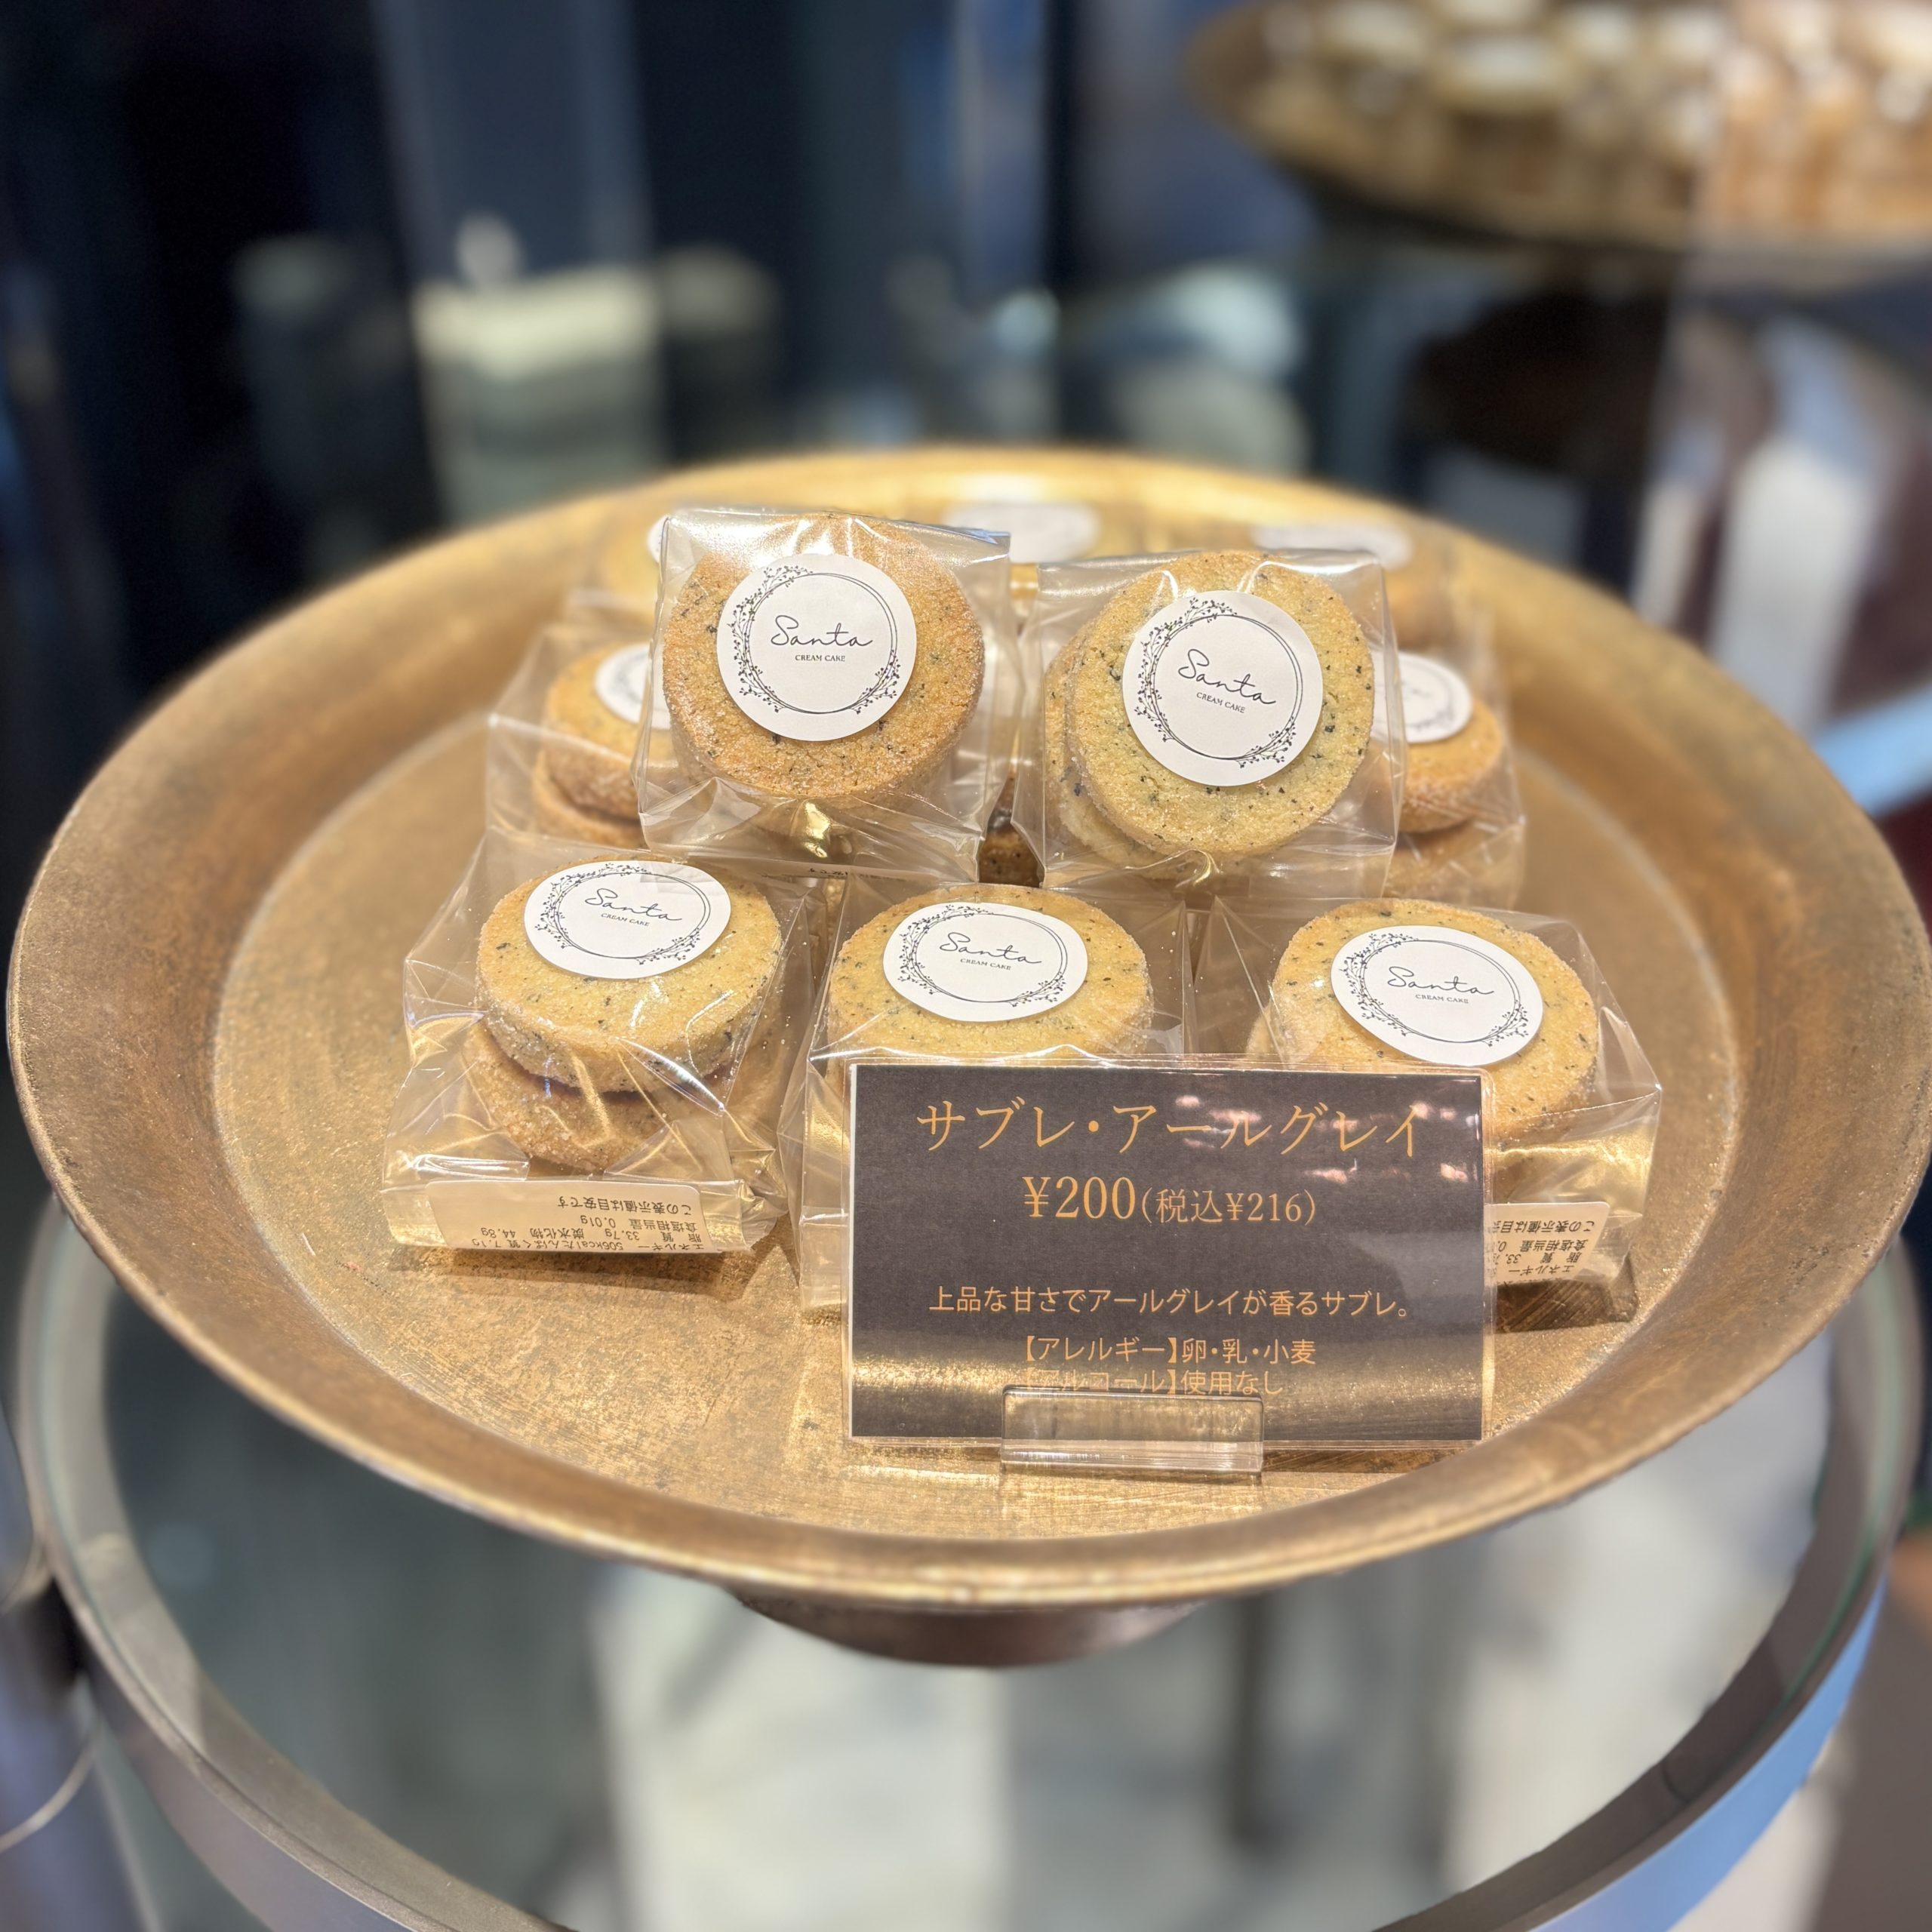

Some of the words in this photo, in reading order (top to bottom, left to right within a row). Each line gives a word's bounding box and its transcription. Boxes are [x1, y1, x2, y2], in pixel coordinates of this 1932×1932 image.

[771, 614, 873, 647] Santa
[1178, 648, 1276, 705] Santa
[1196, 692, 1223, 706] CREAM
[1224, 701, 1245, 713] CAKE
[584, 888, 682, 921] Santa
[601, 912, 627, 922] CREAM
[629, 918, 649, 927] CAKE
[940, 931, 1042, 964] Santa
[960, 958, 988, 966] CREAM
[989, 962, 1011, 971] CAKE
[1387, 966, 1494, 995] Santa
[916, 1096, 1420, 1157] サブレ・アールグレイ
[557, 1196, 692, 1216] この表示値は目安です
[628, 1219, 697, 1233] 食塩相当量
[1519, 1239, 1589, 1252] 食塩相当量
[1509, 1265, 1575, 1277] エネルギー
[929, 1285, 1410, 1318] 上品な甘さでアールグレイが香るサブレ。
